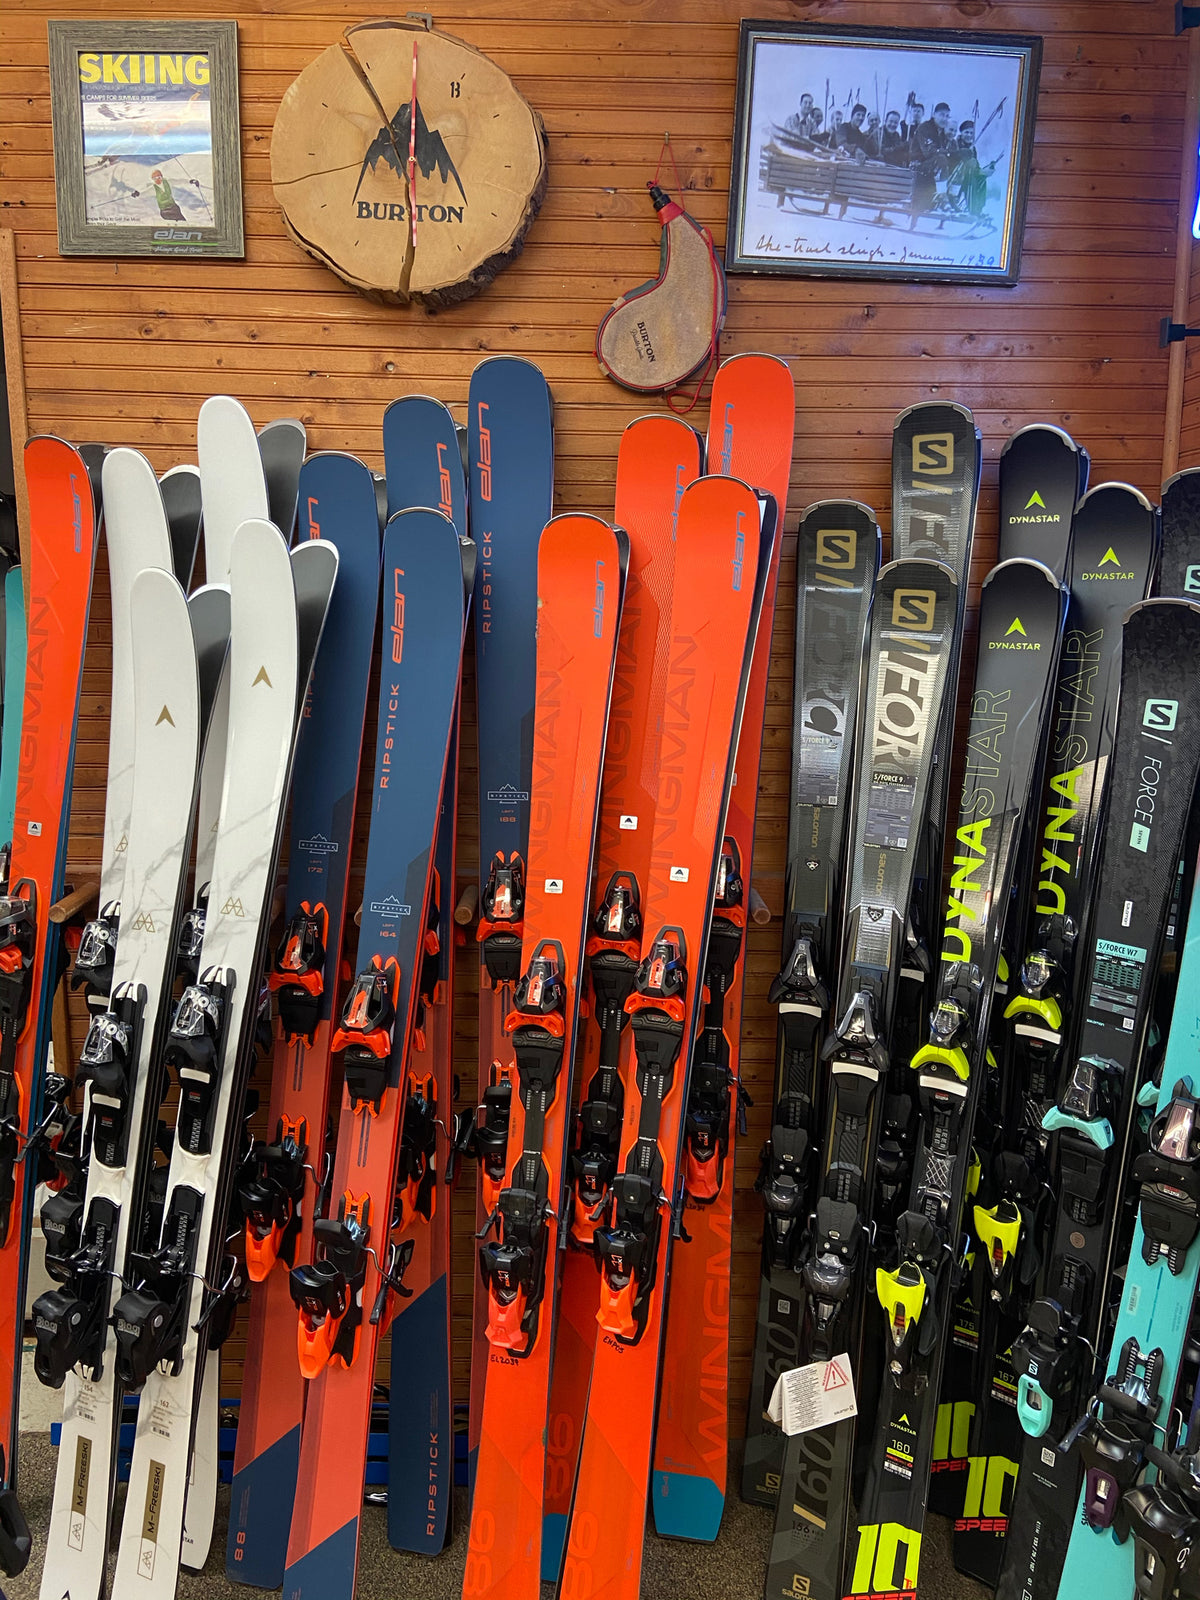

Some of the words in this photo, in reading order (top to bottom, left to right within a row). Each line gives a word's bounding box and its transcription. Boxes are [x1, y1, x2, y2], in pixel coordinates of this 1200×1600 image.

[78, 53, 210, 86] SKIING
[356, 201, 464, 224] BURTON
[153, 228, 203, 241] elan
[637, 321, 656, 363] BURTON
[477, 401, 492, 502] elan
[436, 442, 453, 522] lan
[69, 474, 82, 554] elan
[308, 497, 320, 541] an
[1009, 514, 1060, 524] DYNASTAR
[732, 511, 746, 591] elan
[482, 531, 493, 634] RIPSTICK
[1082, 571, 1135, 581] DYNASTAR
[390, 567, 405, 664] elan
[592, 560, 605, 638] elan
[988, 641, 1041, 651] DYNASTAR
[303, 669, 316, 719] RIPS
[379, 683, 400, 789] RIPSTICK
[874, 773, 898, 783] S/FORCE
[898, 776, 904, 784] 9
[1036, 628, 1104, 916] DYNASTAR
[1134, 755, 1162, 824] FORCE
[940, 689, 1011, 963] DYNASTAR
[380, 930, 396, 938] 164
[1098, 941, 1126, 955] S/FORCE
[1127, 948, 1138, 957] W7
[959, 1318, 975, 1330] 175
[84, 1384, 93, 1393] 154
[998, 1369, 1015, 1383] 167
[890, 1421, 917, 1436] DYNASTAR
[891, 1439, 911, 1454] 160
[426, 1431, 439, 1537] RIPSTICK
[930, 1459, 966, 1473] SPE
[963, 1455, 1020, 1518] 10
[954, 1519, 1009, 1532] SPEE
[234, 1531, 246, 1561] 88
[851, 1522, 922, 1594] 10
